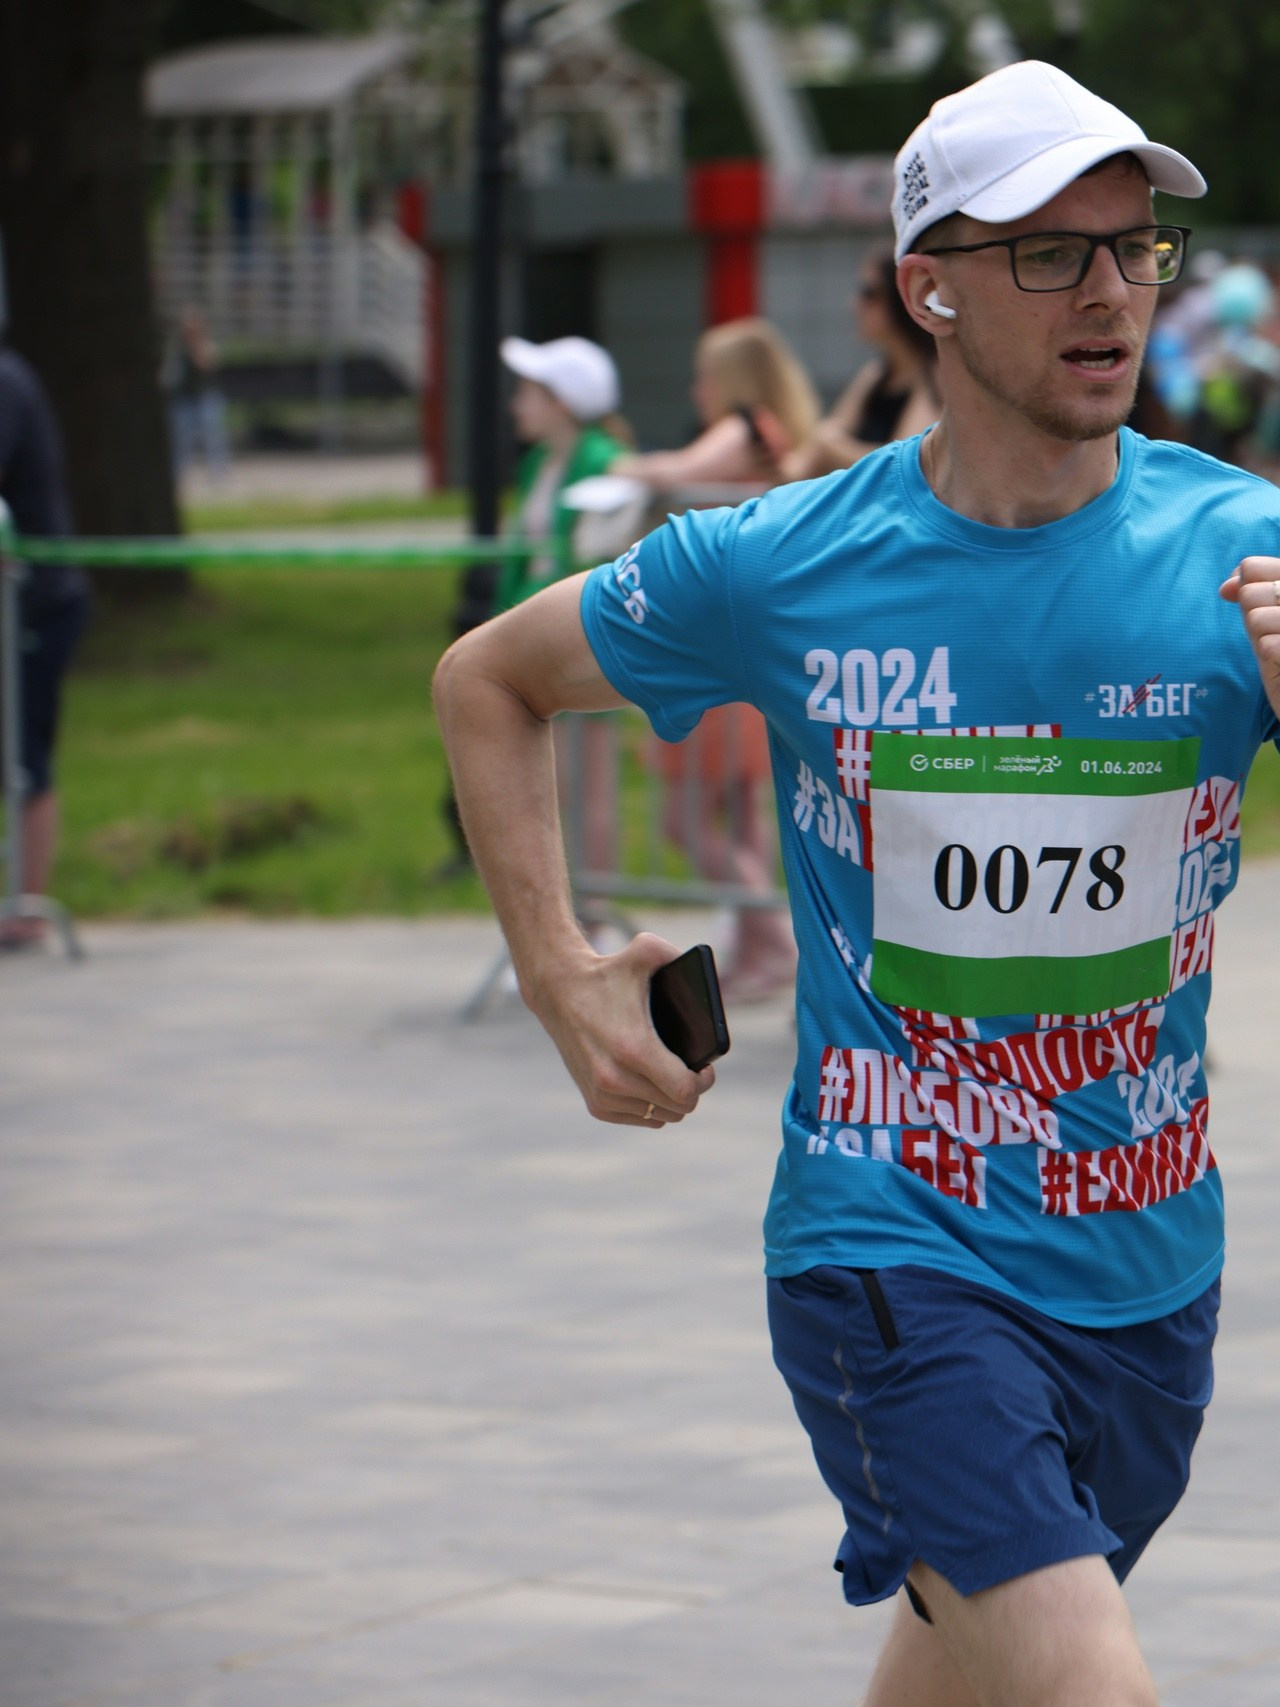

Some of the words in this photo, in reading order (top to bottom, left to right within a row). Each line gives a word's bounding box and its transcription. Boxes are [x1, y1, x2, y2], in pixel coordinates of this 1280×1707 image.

[804, 646, 958, 726] 2024
[932, 757, 975, 770] СБЕР
[1080, 760, 1163, 775] 01.06.2024
[933, 843, 1127, 914] 0078
